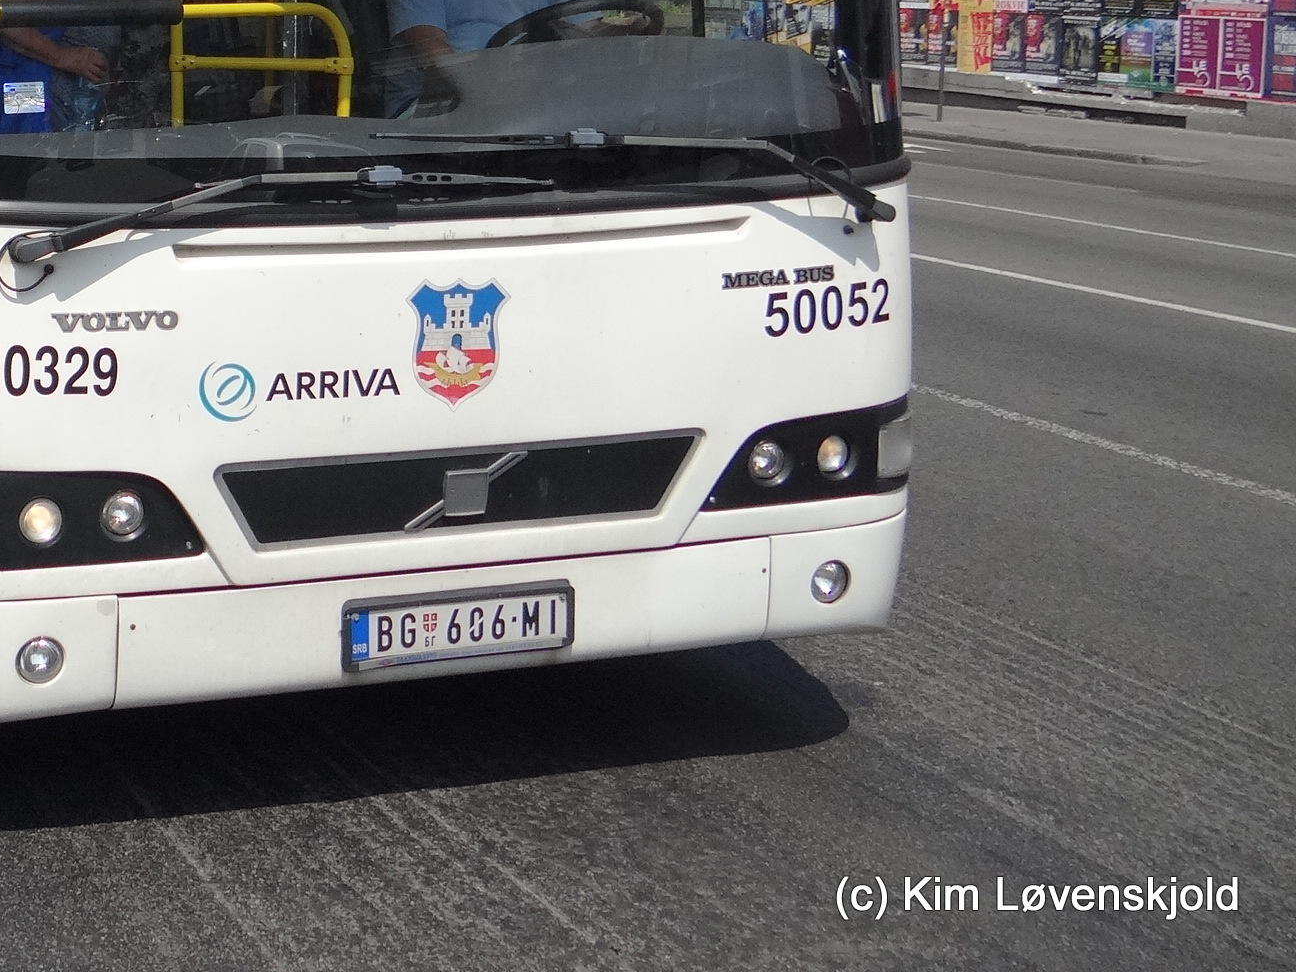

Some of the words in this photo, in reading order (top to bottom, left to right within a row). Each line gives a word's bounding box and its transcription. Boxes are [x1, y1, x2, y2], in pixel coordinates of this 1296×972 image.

[721, 269, 790, 290] MEGA
[793, 264, 835, 285] BUS
[51, 310, 179, 333] VOLVO
[764, 278, 890, 337] 50052
[266, 367, 401, 403] ARRIVA
[352, 642, 368, 654] SRB
[376, 612, 417, 653] BG
